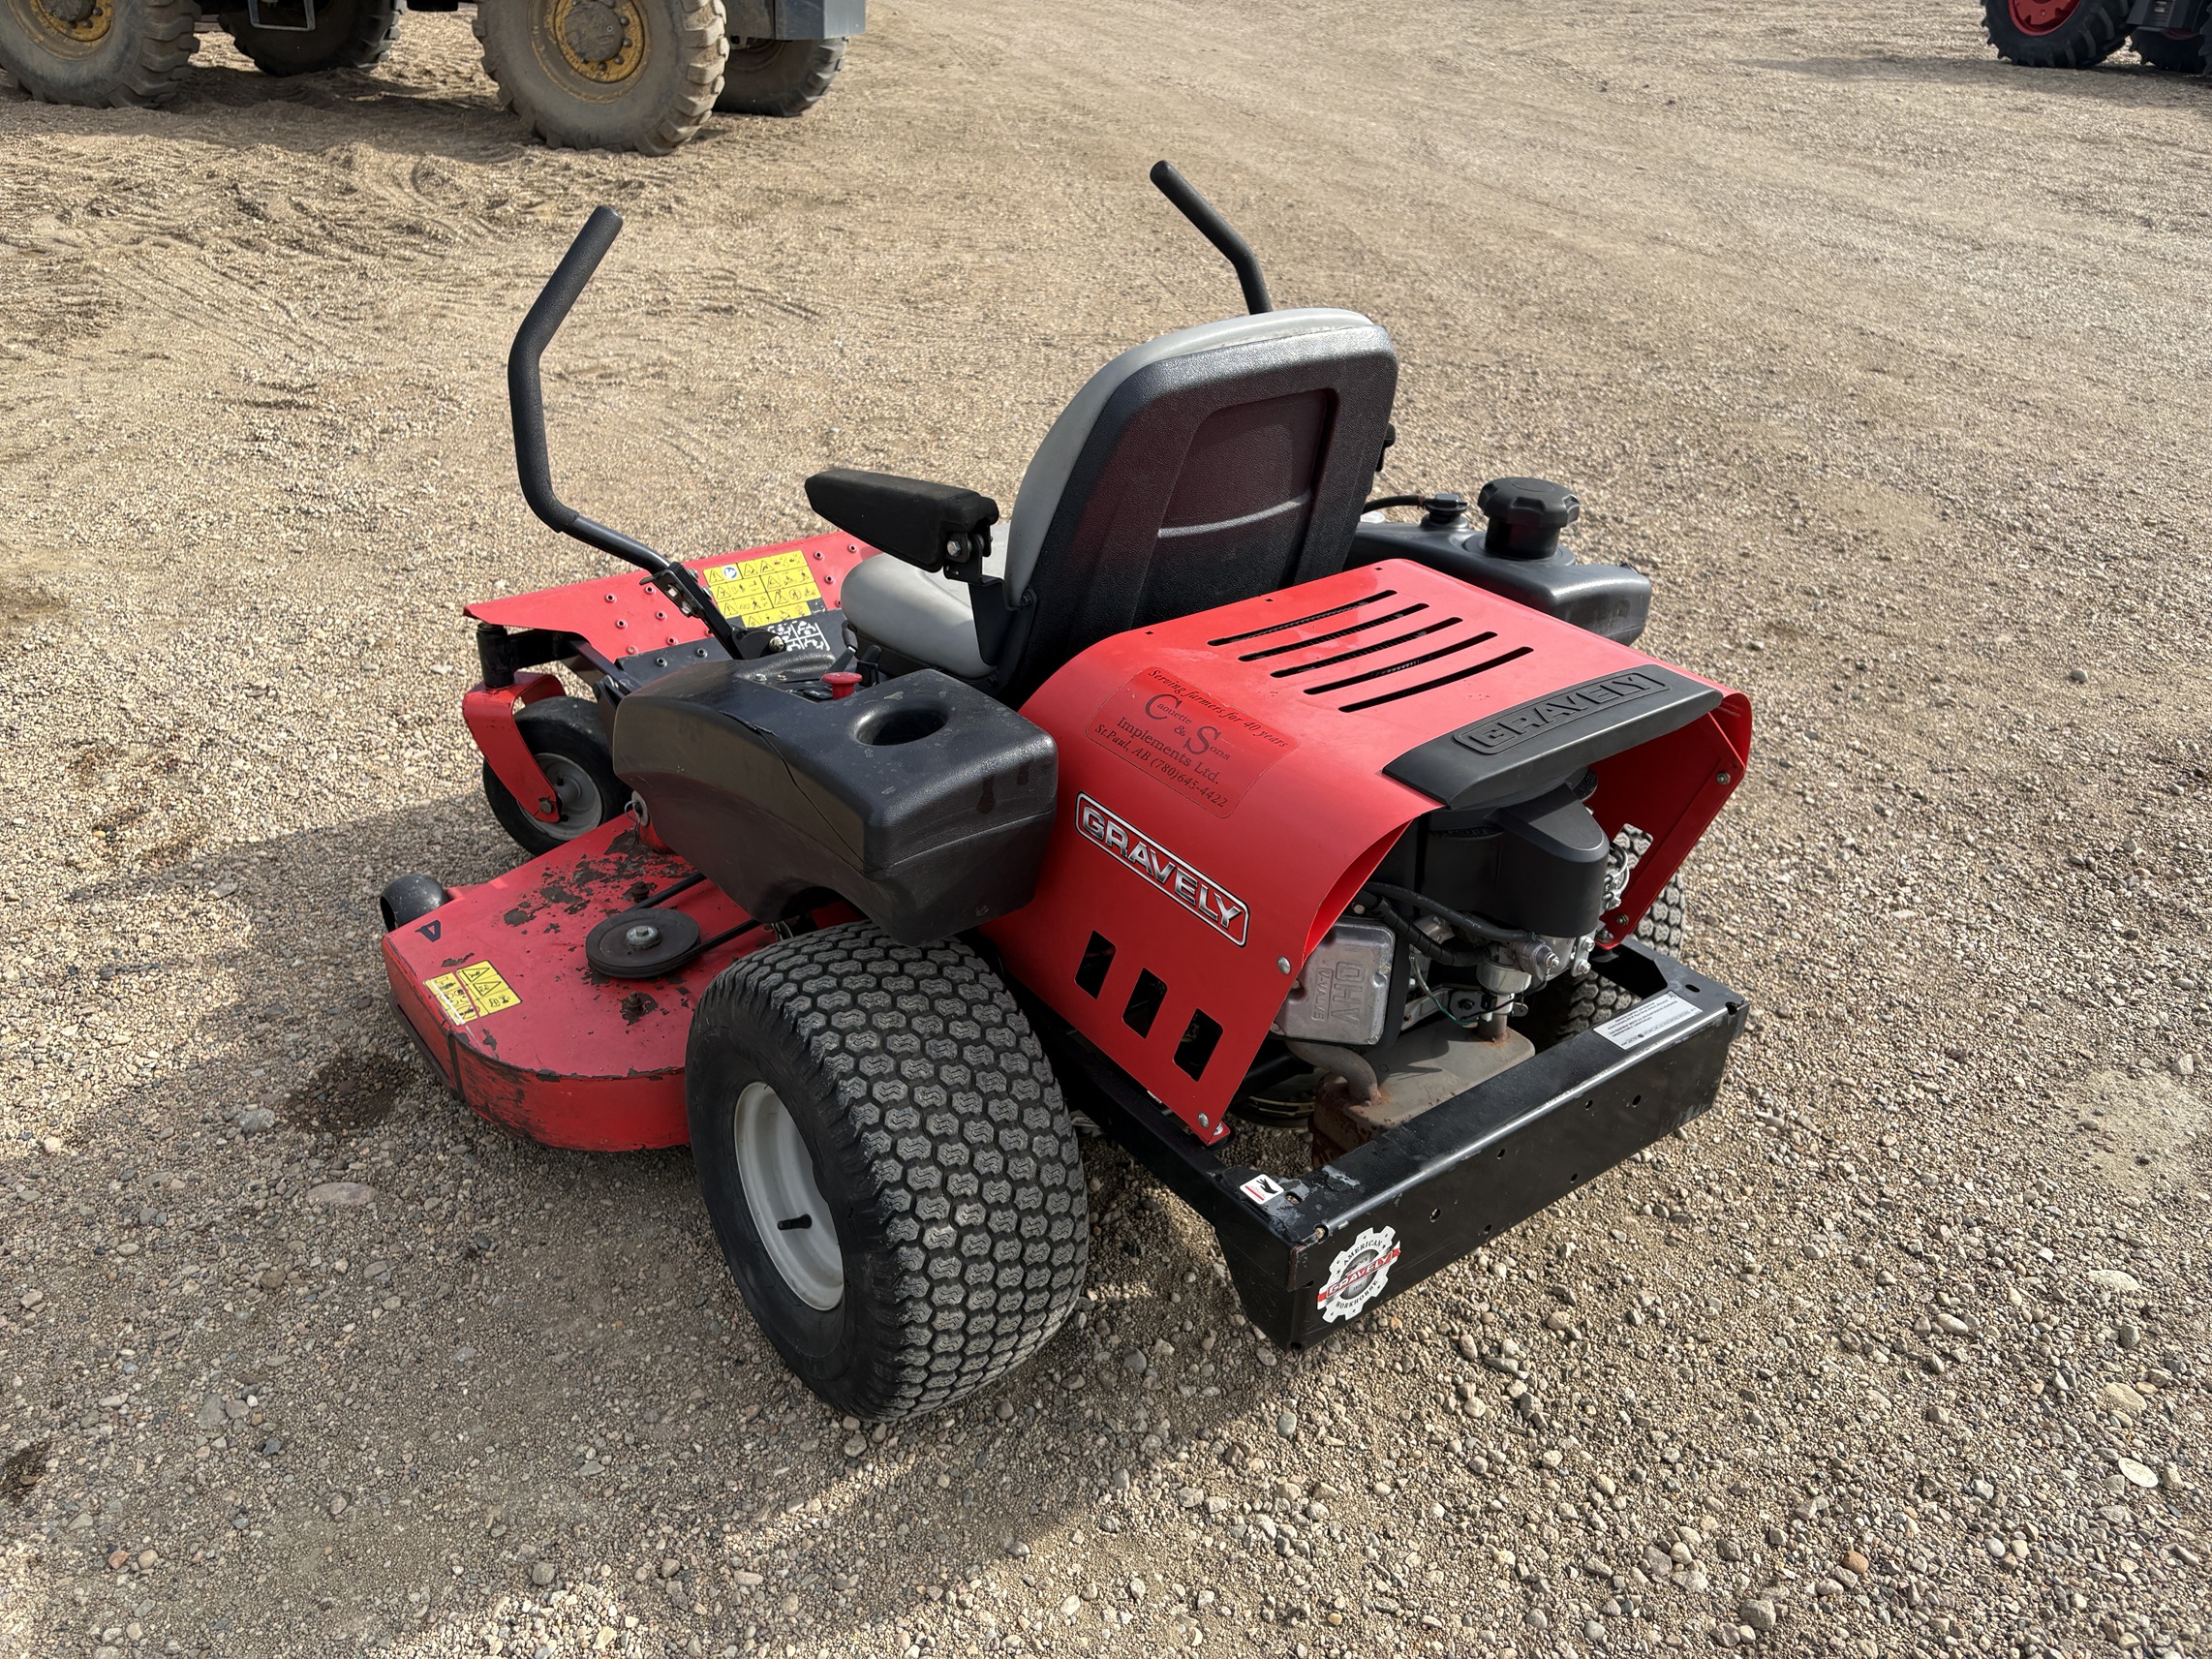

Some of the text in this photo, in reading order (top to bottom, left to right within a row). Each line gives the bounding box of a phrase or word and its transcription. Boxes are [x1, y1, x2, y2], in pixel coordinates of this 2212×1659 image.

[1149, 669, 1288, 749] Serving farmers for 40 years
[1469, 675, 1651, 748] GRAVELY
[1117, 716, 1219, 785] Implements Ltd.
[1131, 747, 1151, 761] AB
[1174, 725, 1186, 737] &
[1183, 725, 1231, 761] Sons
[1083, 806, 1242, 929] GRAVELY
[1331, 961, 1367, 1026] OHV
[1329, 1250, 1393, 1294] GRAVELY
[1343, 1240, 1383, 1266] AMERICAN
